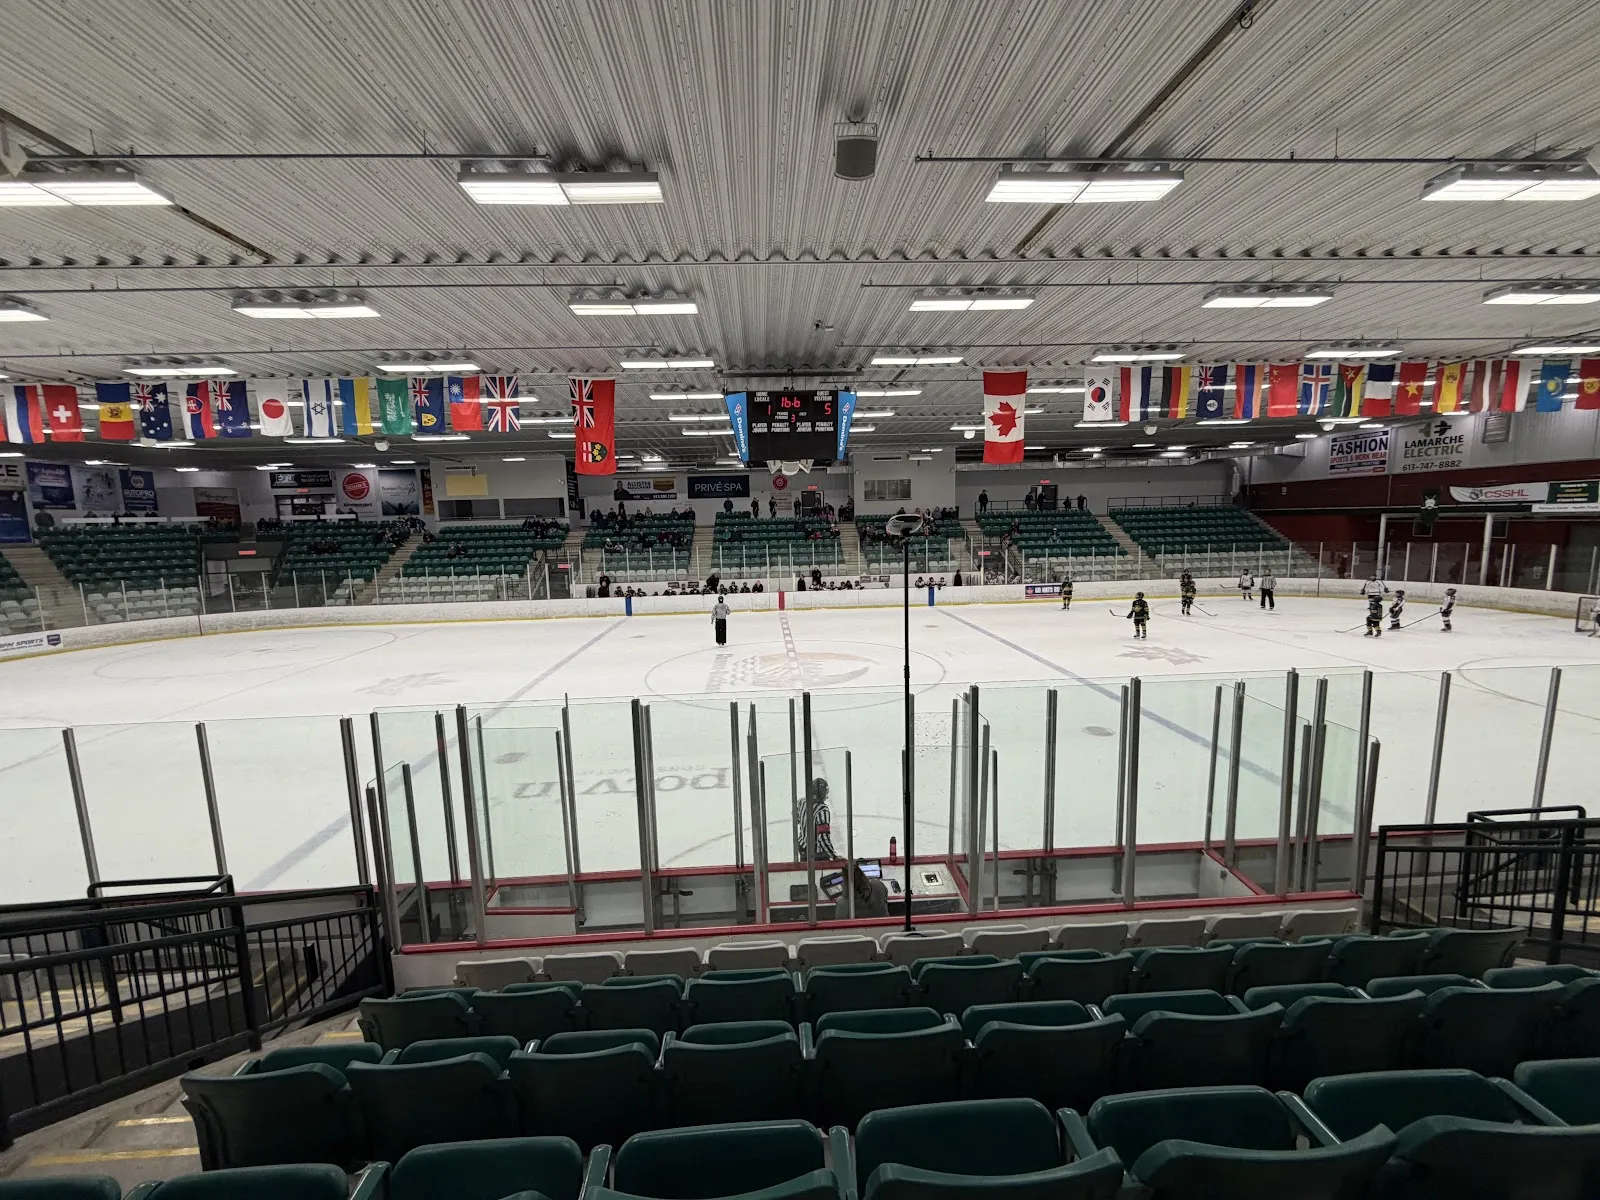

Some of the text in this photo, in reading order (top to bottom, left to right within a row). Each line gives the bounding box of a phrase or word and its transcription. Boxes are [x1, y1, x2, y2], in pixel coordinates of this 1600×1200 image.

[825, 403, 832, 415] 5
[736, 416, 746, 453] Domino's
[839, 415, 848, 451] Domino's
[1330, 437, 1388, 456] FASHION
[1405, 435, 1464, 449] LAMARCHE
[1404, 444, 1464, 458] ELECTRIC
[1403, 460, 1461, 471] 613-747-8882
[694, 481, 742, 492] PRIVÉ SPA
[124, 489, 154, 498] AUTOPRO
[1484, 489, 1528, 498] CSSHL
[16, 638, 43, 646] SPORTS
